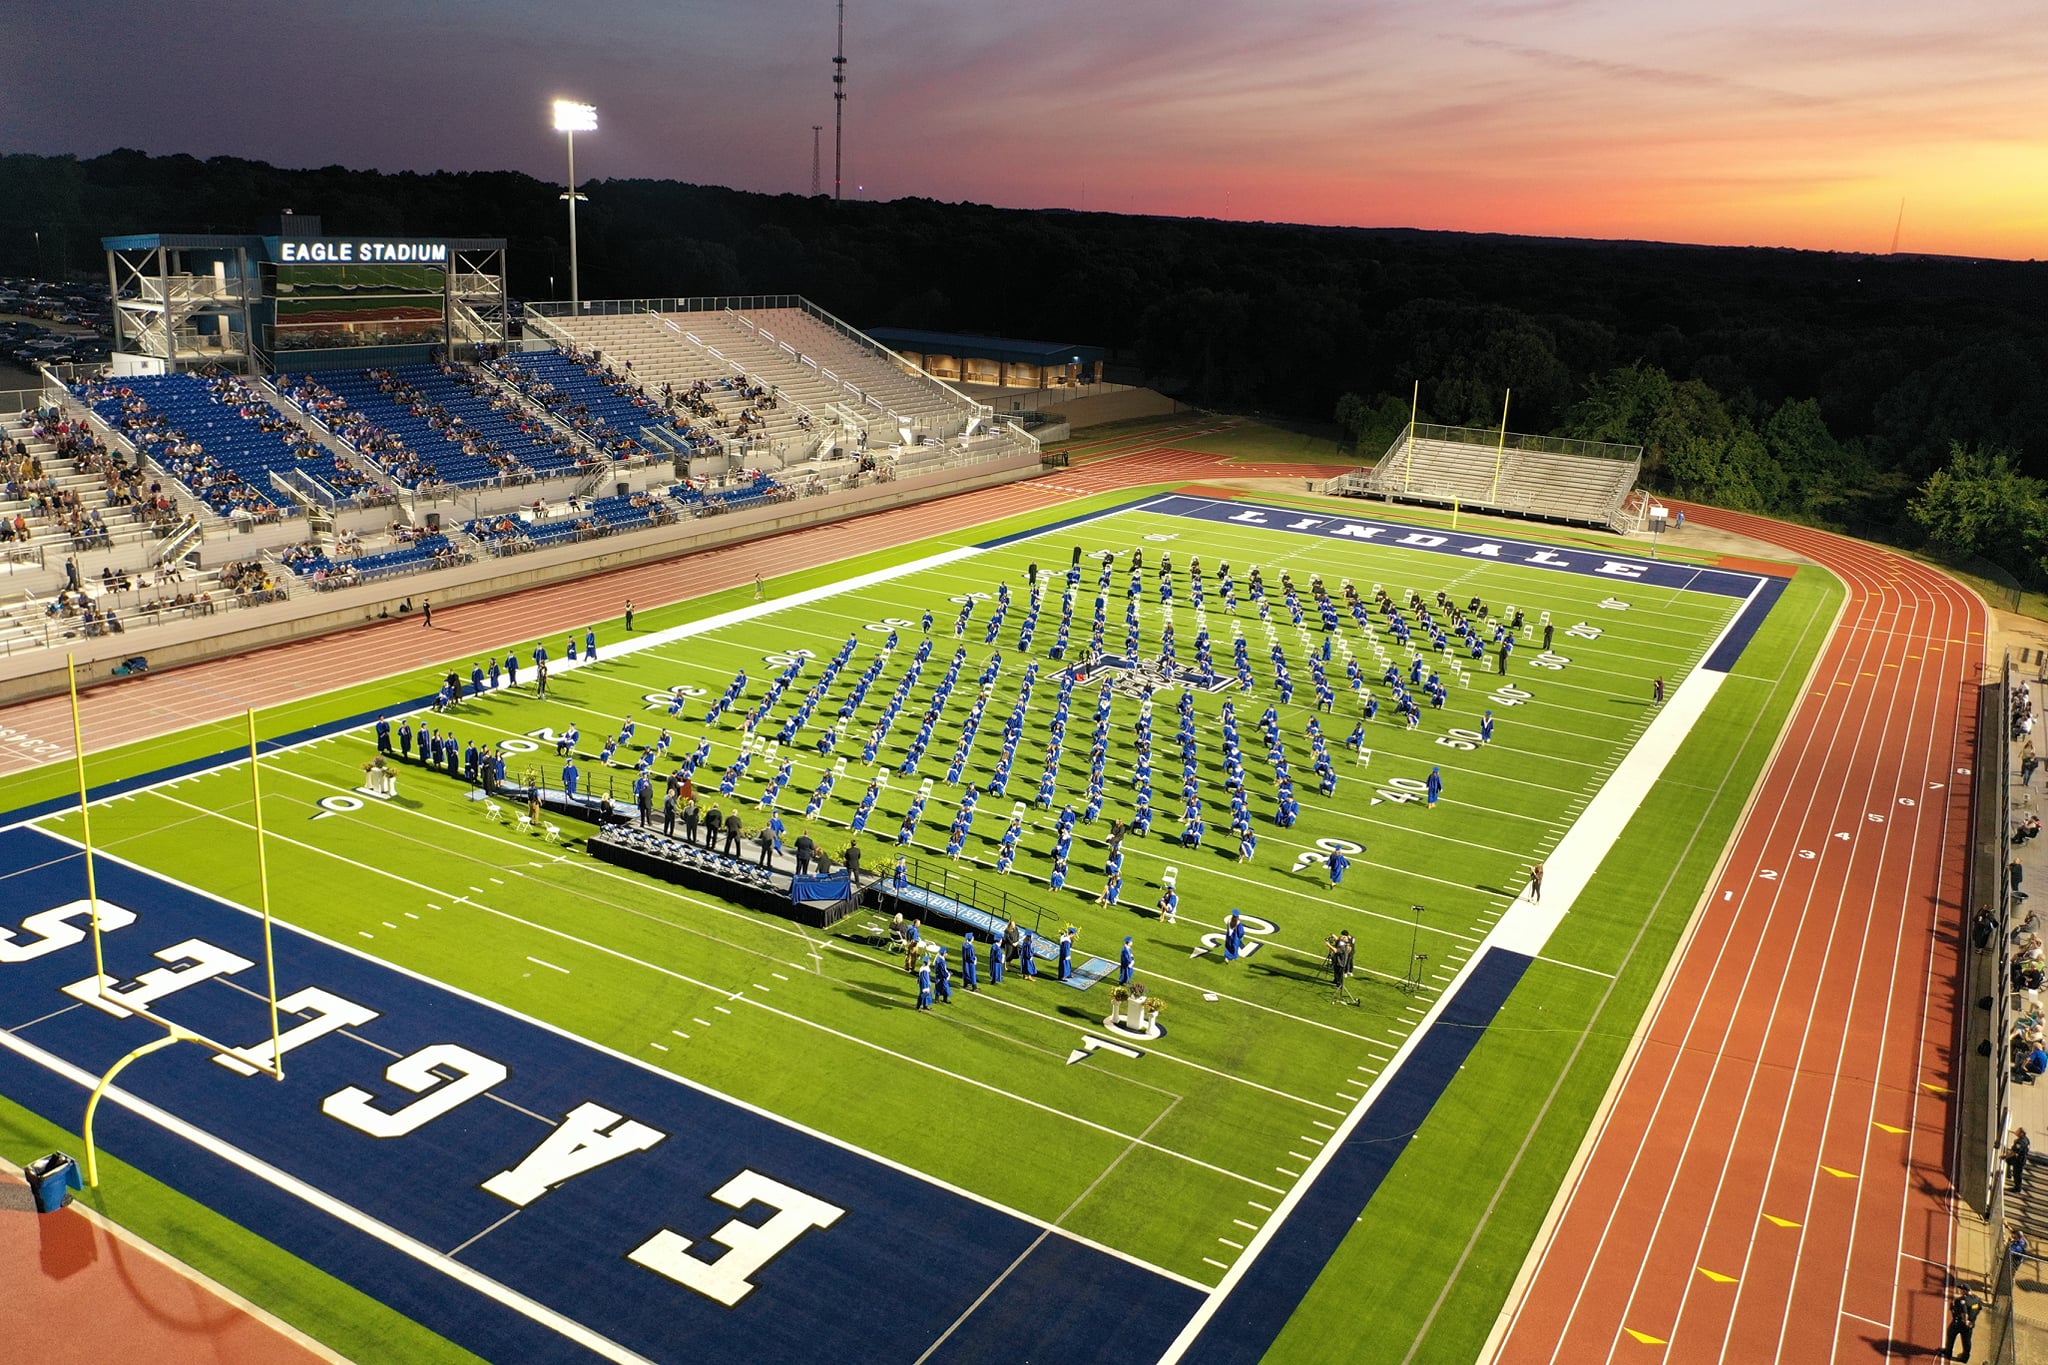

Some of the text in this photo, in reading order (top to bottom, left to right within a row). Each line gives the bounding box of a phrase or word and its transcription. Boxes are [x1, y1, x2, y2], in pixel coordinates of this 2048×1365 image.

[282, 243, 446, 261] EAGLE STADIUM
[1228, 511, 1648, 577] LINDALE
[1529, 654, 1573, 670] 30
[1488, 688, 1536, 706] 40
[1435, 728, 1484, 751] 50
[1376, 778, 1428, 804] 40
